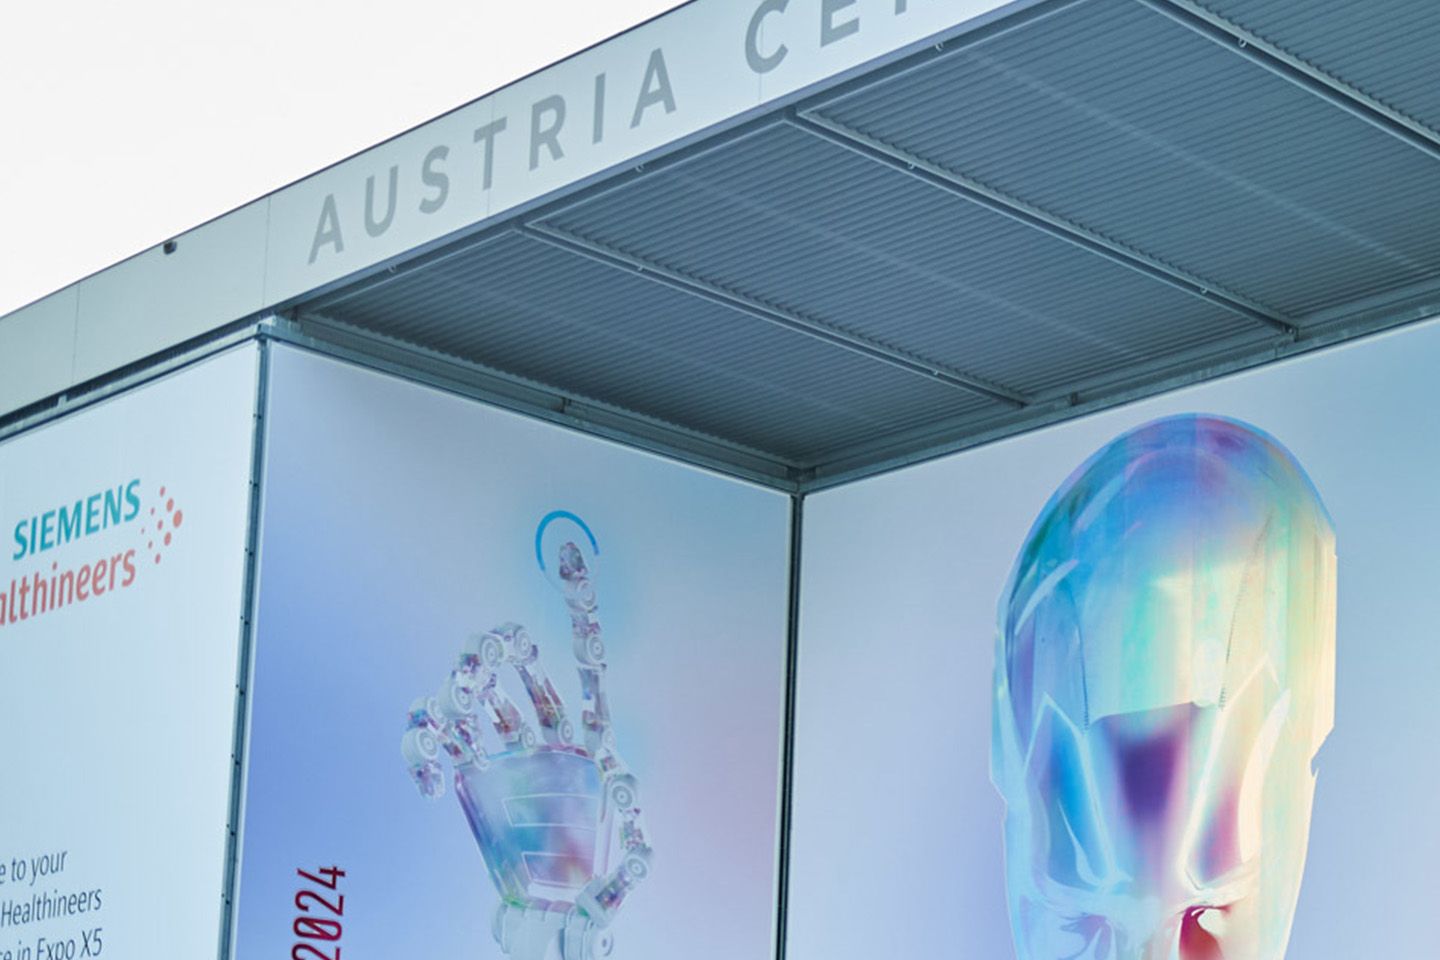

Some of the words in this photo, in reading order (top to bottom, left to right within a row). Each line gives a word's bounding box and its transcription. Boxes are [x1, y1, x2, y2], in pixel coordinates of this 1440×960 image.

[307, 47, 677, 265] AUSTRIA
[745, 0, 907, 74] CE
[13, 478, 141, 561] SIEMENS
[11, 858, 26, 882] to
[29, 850, 68, 887] your
[1, 888, 102, 928] Healthineers
[80, 927, 103, 959] X5
